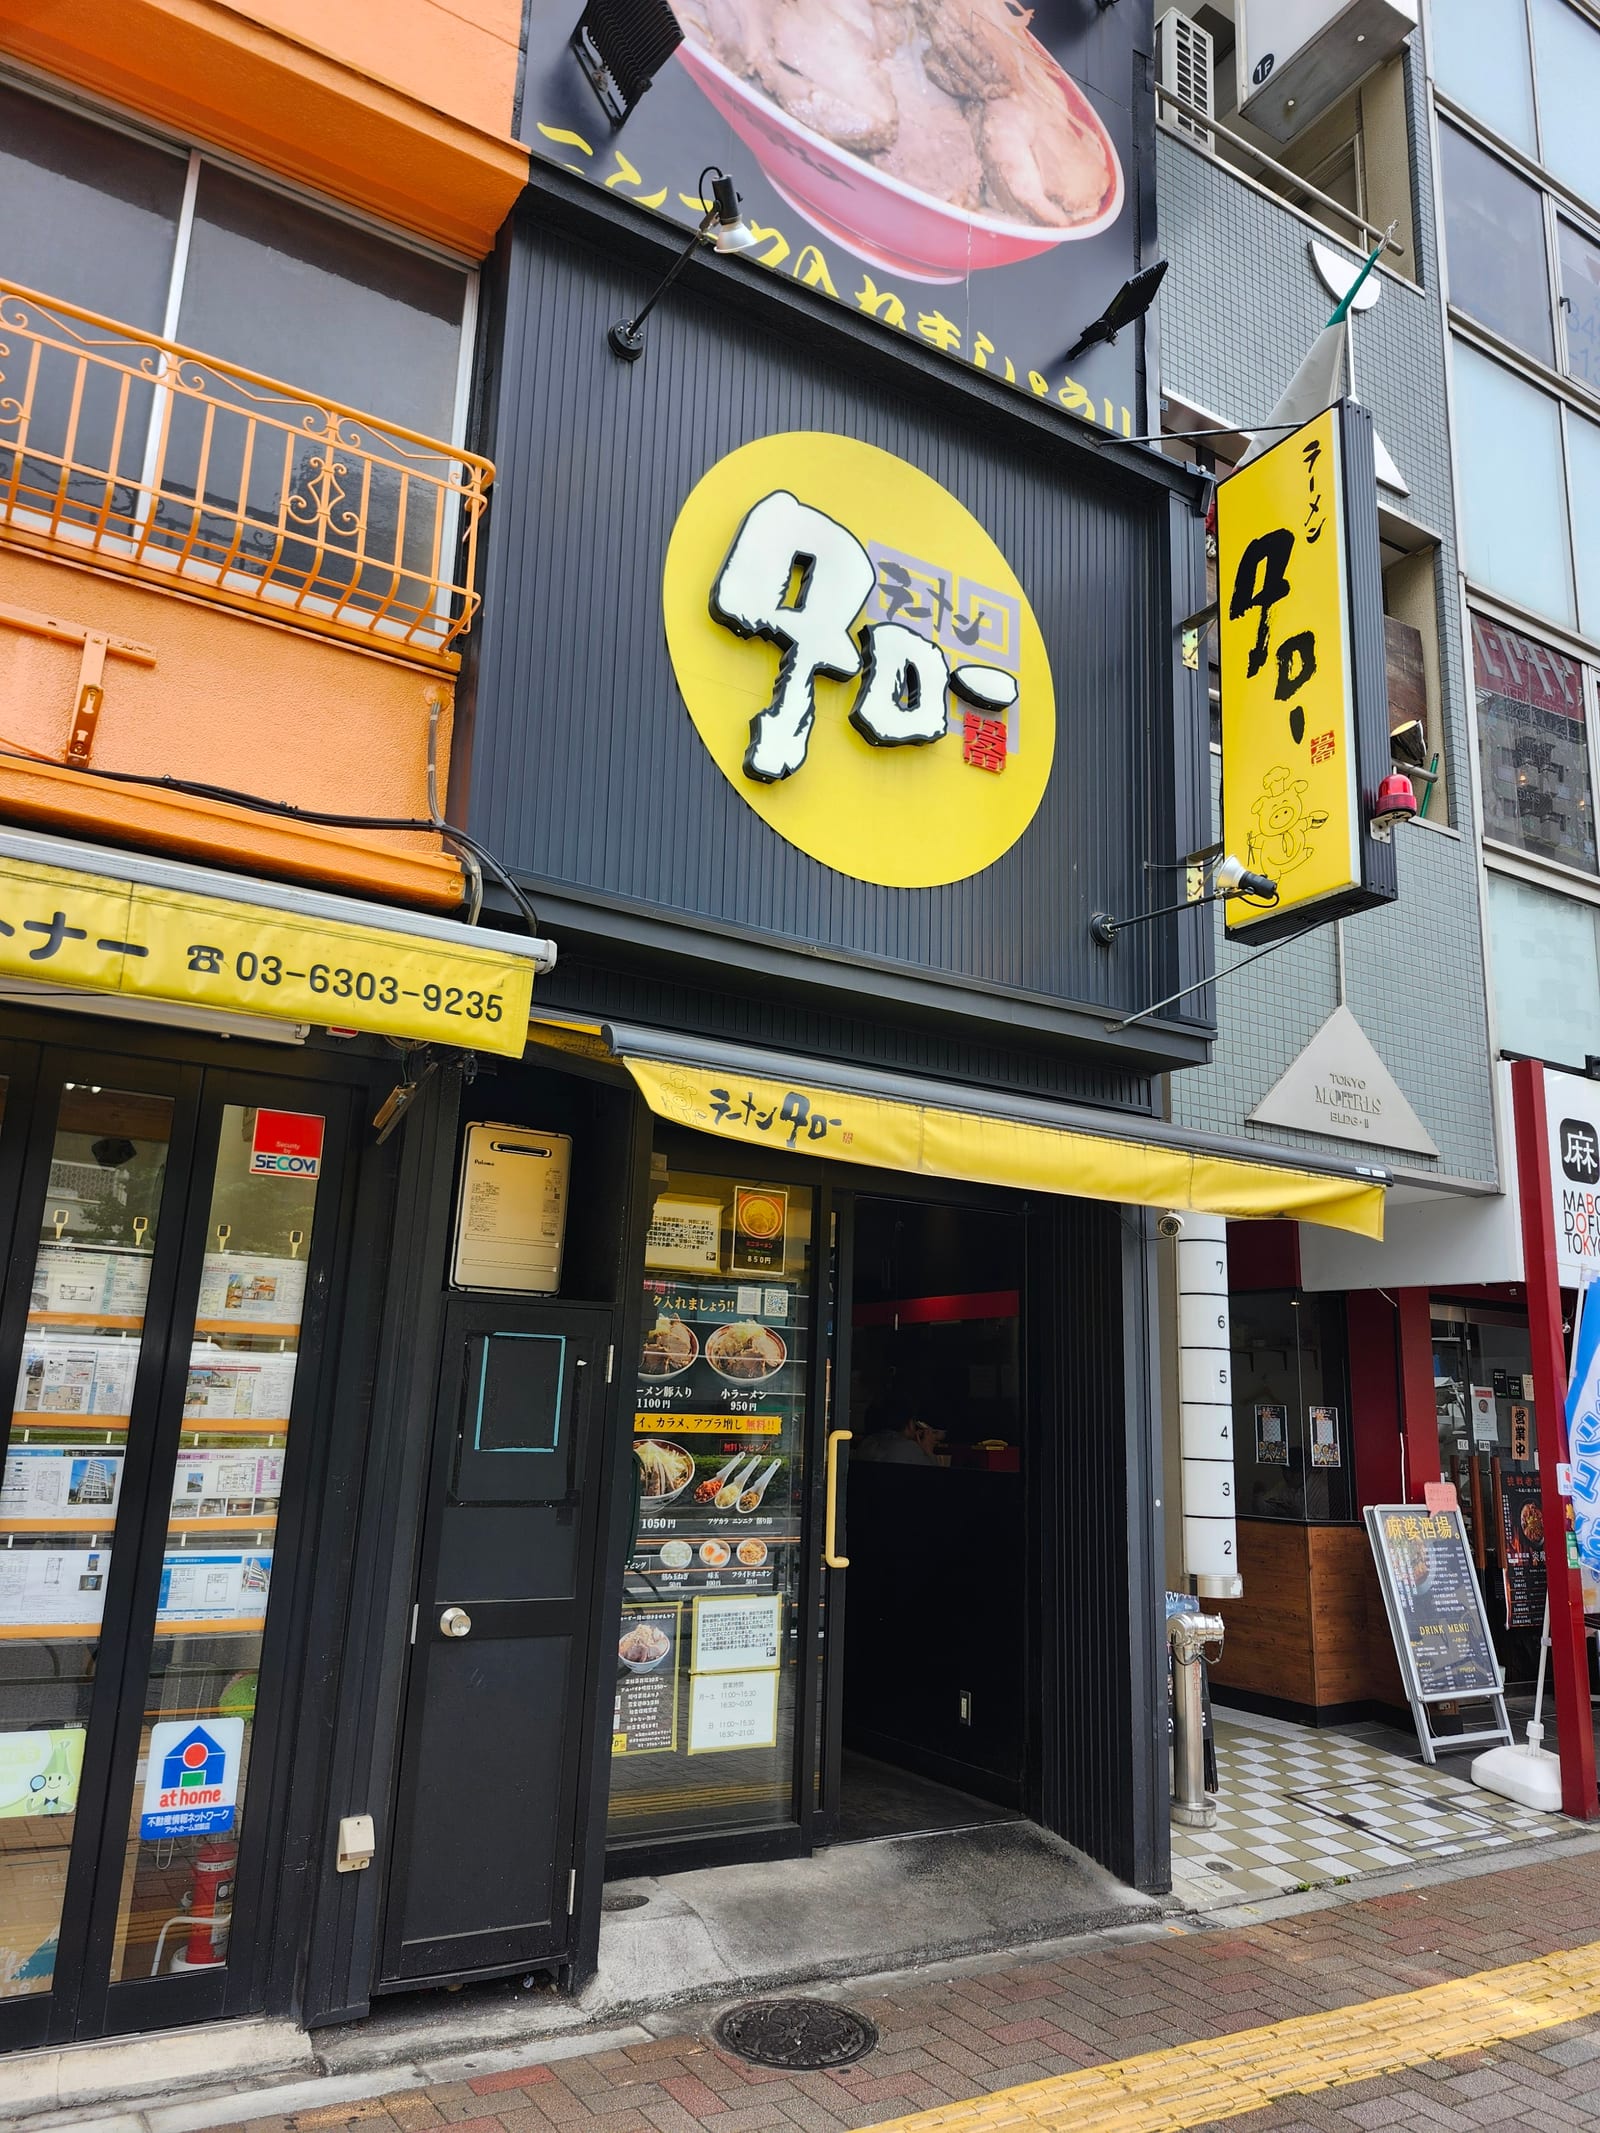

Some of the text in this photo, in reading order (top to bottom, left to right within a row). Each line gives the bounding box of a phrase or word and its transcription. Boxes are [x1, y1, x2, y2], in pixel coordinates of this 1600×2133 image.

[1255, 58, 1272, 83] 1F
[1303, 439, 1326, 544] ラーメン
[877, 560, 984, 647] ラーメン
[236, 950, 504, 1023] 03-6303-9235
[1329, 1073, 1366, 1090] TOKYO
[1314, 1085, 1382, 1115] MORRIS
[275, 1140, 301, 1150] Security
[283, 1147, 292, 1155] by
[1564, 1131, 1598, 1174] 麻
[255, 1154, 317, 1173] SECOM
[1565, 1232, 1600, 1256] TOKY
[1216, 1260, 1224, 1275] 7
[653, 1296, 735, 1313] ク入れましょう!!
[1217, 1315, 1226, 1329] 6
[1219, 1370, 1227, 1384] 5
[720, 1388, 767, 1400] 小ラーメン
[637, 1398, 671, 1409] 1100円
[730, 1401, 758, 1411] 950円
[1220, 1426, 1228, 1440] 4
[1514, 1409, 1526, 1457] 営業中
[1222, 1482, 1231, 1496] 3
[641, 1518, 676, 1529] 1050円
[732, 1517, 753, 1525] ニンニク
[1386, 1515, 1460, 1541] 麻婆酒場。
[1223, 1540, 1233, 1555] 2
[732, 1571, 772, 1579] フライドオニオン
[1419, 1622, 1470, 1637] DRINK MENU
[159, 1789, 222, 1808] at home
[147, 1809, 229, 1827] 不動産情報ネットワーク
